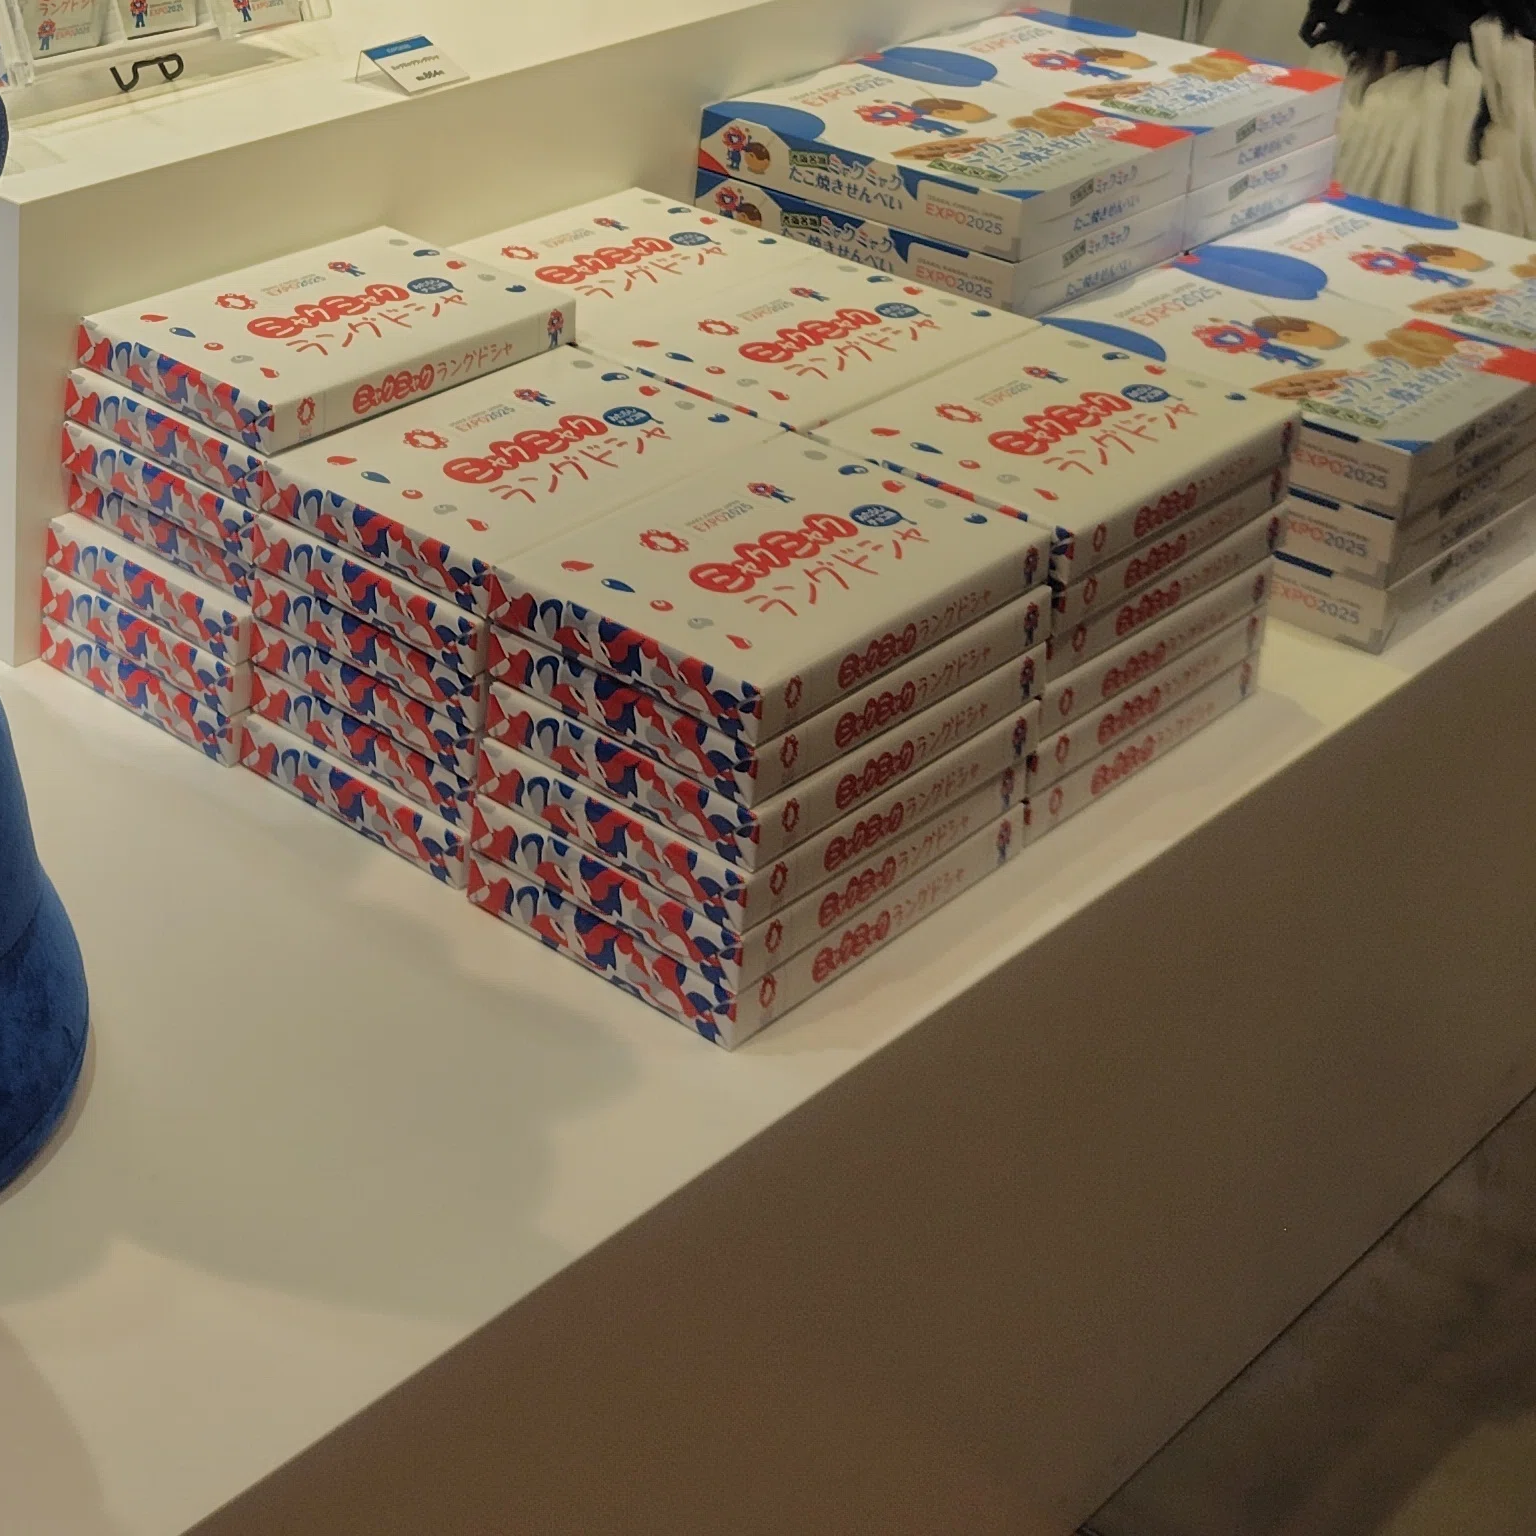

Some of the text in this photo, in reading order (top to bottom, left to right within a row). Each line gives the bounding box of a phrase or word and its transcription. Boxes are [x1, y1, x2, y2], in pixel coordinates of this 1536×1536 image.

[789, 166, 904, 211] たこ焼きせんべい
[925, 202, 1004, 236] EXPO2025
[535, 237, 674, 285] ミャクミャク
[574, 246, 727, 299] ラングドシャ
[916, 265, 994, 300] EXPO2025
[247, 284, 410, 339] ミャクミャク
[286, 295, 467, 355] ラングドシャ
[738, 308, 882, 363] ミャクミャク
[783, 319, 943, 380] ラングドシャ
[443, 414, 608, 484] ミャクミャク
[988, 391, 1133, 456] ミャクミャク
[1042, 403, 1200, 475] ラングドシャ
[489, 425, 673, 505] ラングドシャ
[688, 513, 859, 594] ミャクミャク
[1287, 520, 1369, 558] XPO2025
[744, 526, 930, 617] ラングドシャ
